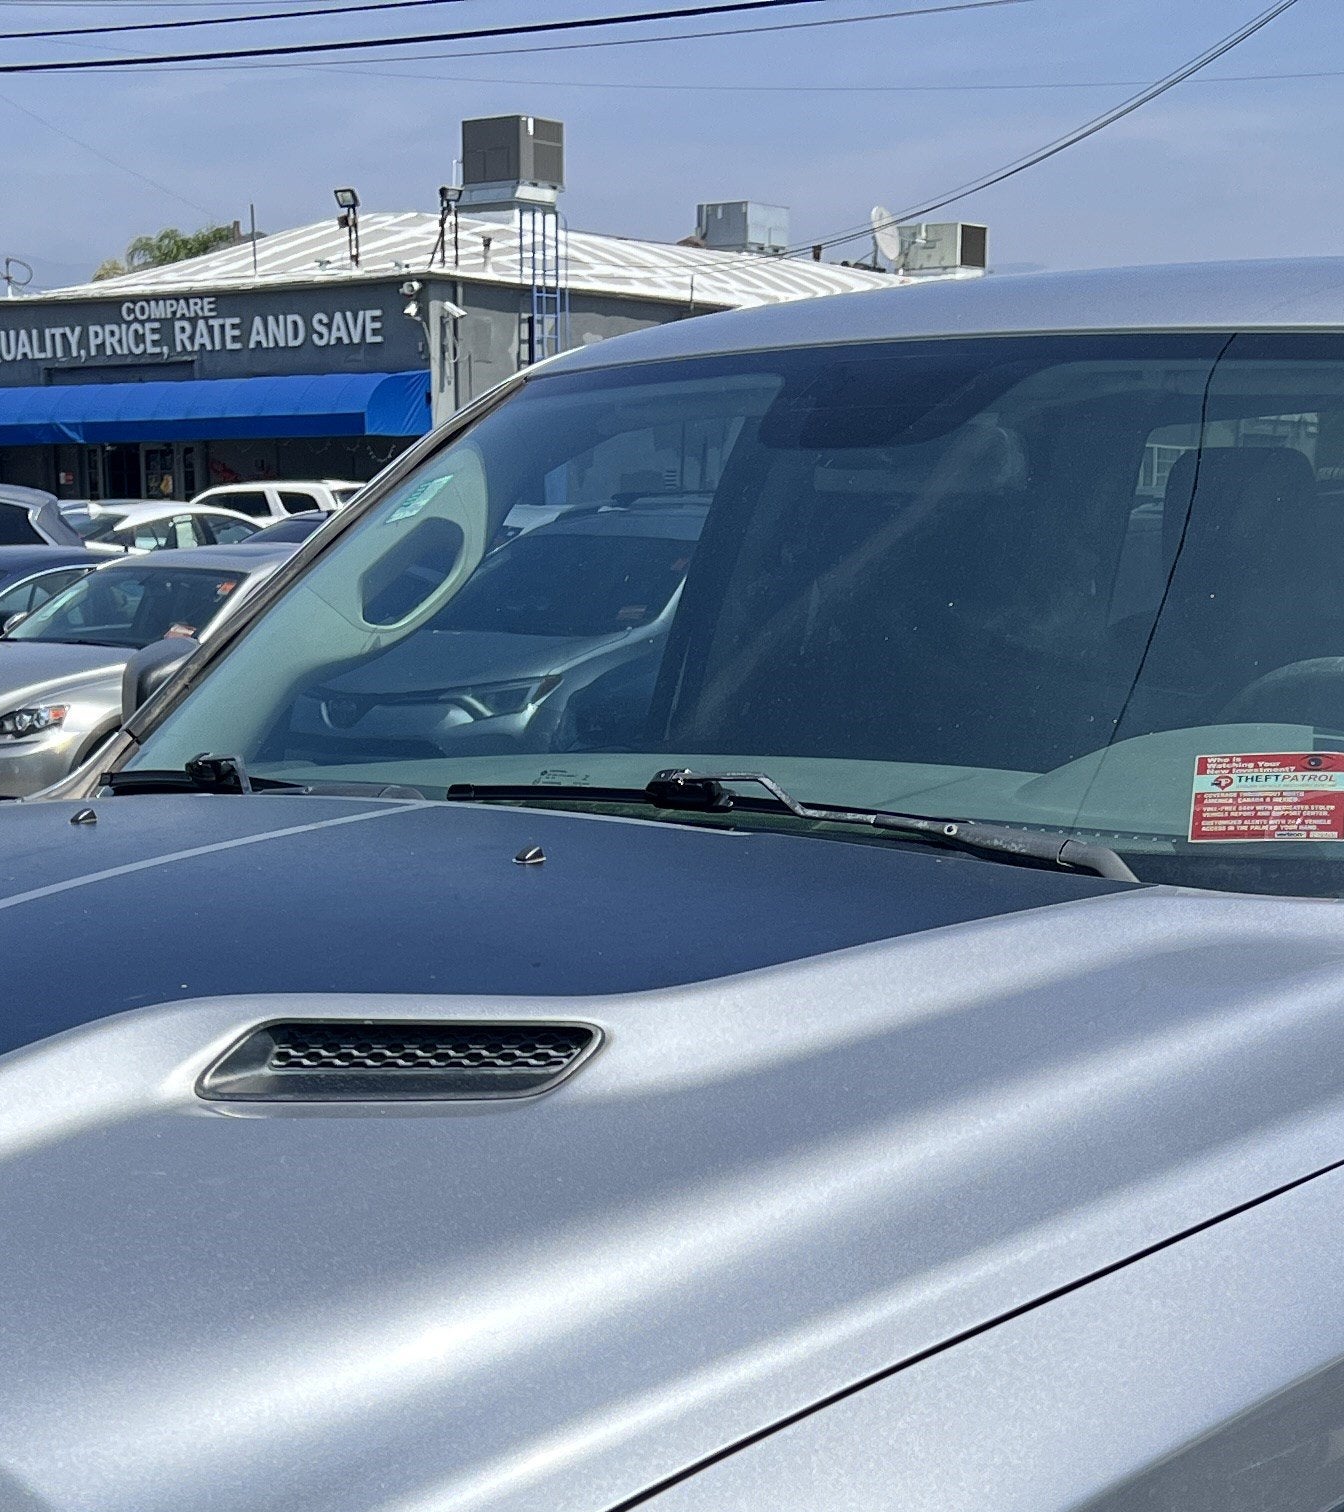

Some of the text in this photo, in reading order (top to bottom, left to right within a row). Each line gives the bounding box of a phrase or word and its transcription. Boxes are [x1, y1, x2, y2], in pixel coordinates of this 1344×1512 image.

[121, 297, 218, 321] COMPARE
[88, 322, 169, 360] PRICE,
[174, 317, 243, 352] RATE
[249, 313, 306, 349] AND
[311, 309, 384, 347] SAVE
